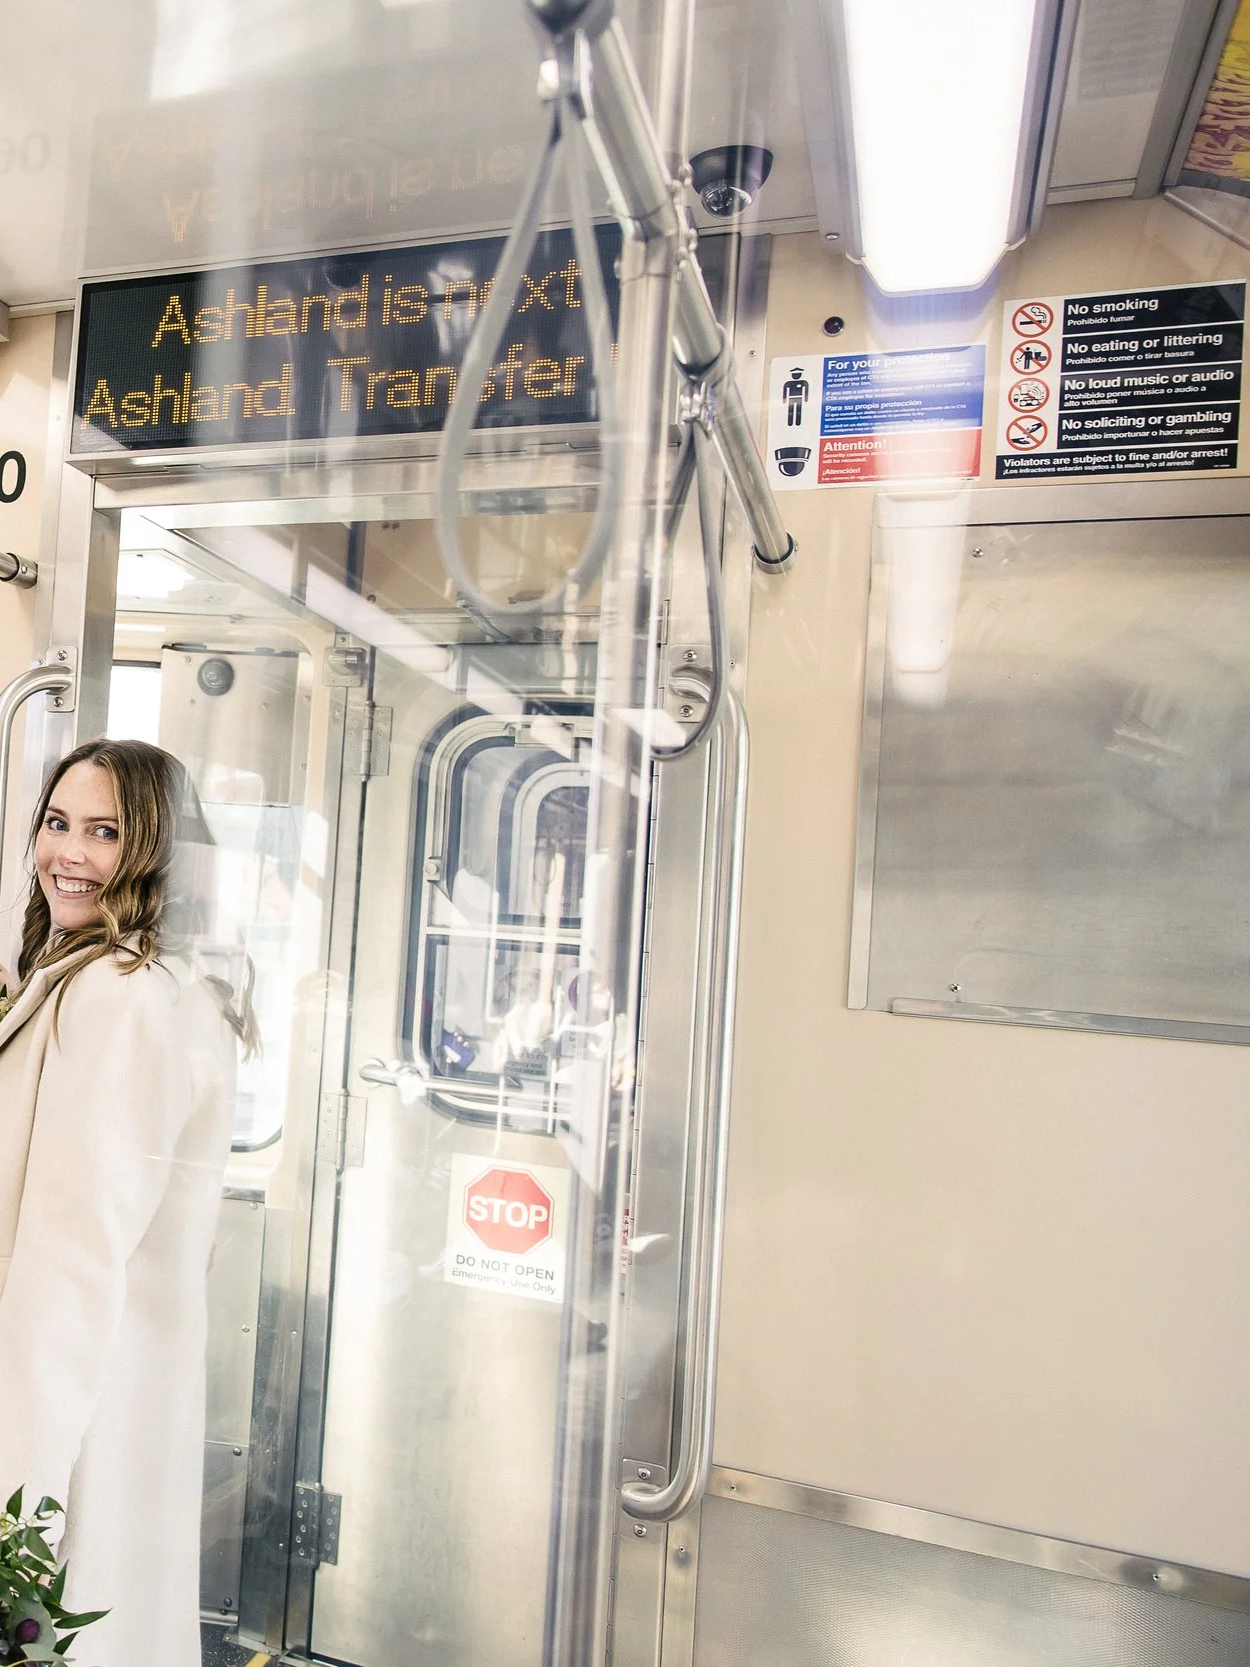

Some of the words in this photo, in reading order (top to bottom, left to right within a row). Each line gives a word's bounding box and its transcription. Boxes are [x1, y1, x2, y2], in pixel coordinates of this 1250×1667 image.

[152, 274, 370, 349] Ashland
[382, 274, 429, 326] is
[1067, 304, 1088, 315] No
[1092, 298, 1159, 313] smoking
[1067, 316, 1108, 326] Prohibido
[1110, 314, 1135, 322] fumar
[1067, 342, 1088, 354] No
[1092, 339, 1139, 352] eating
[1143, 338, 1160, 348] or
[1164, 332, 1223, 347] littering
[828, 360, 849, 370] For
[852, 359, 880, 370] your
[1066, 355, 1106, 365] Prohibido
[1108, 354, 1135, 362] comer
[1164, 350, 1194, 358] basura
[1064, 379, 1085, 391] No
[1089, 375, 1120, 389] loud
[1124, 372, 1169, 387] music
[1172, 372, 1189, 383] or
[1191, 369, 1234, 382] audio
[80, 364, 297, 430] Ashland
[1064, 391, 1106, 400] Prohibido
[1106, 390, 1132, 398] poner
[1174, 385, 1199, 393] audio
[855, 403, 879, 411] propia
[1082, 398, 1118, 406] volumen
[1062, 418, 1082, 430] No
[1084, 415, 1146, 428] soliciting
[1148, 414, 1164, 423] or
[1166, 410, 1232, 426] gambling
[1062, 432, 1102, 441] Prohibido
[1103, 430, 1150, 440] importunar
[1184, 427, 1224, 435] apuestas
[823, 440, 887, 452] Attention!
[1003, 457, 1051, 468] Violators
[1052, 457, 1071, 465] are
[1073, 453, 1112, 465] subject
[1115, 454, 1127, 462] to
[1128, 452, 1150, 461] fine
[1152, 450, 1189, 460] and/or
[1191, 448, 1228, 457] arrest!
[468, 1195, 548, 1230] STOP
[456, 1254, 476, 1266] DO
[481, 1258, 510, 1273] NOT
[515, 1265, 554, 1280] OPEN
[452, 1268, 506, 1286] Emergency
[510, 1279, 529, 1289] Use
[532, 1282, 556, 1295] Only
